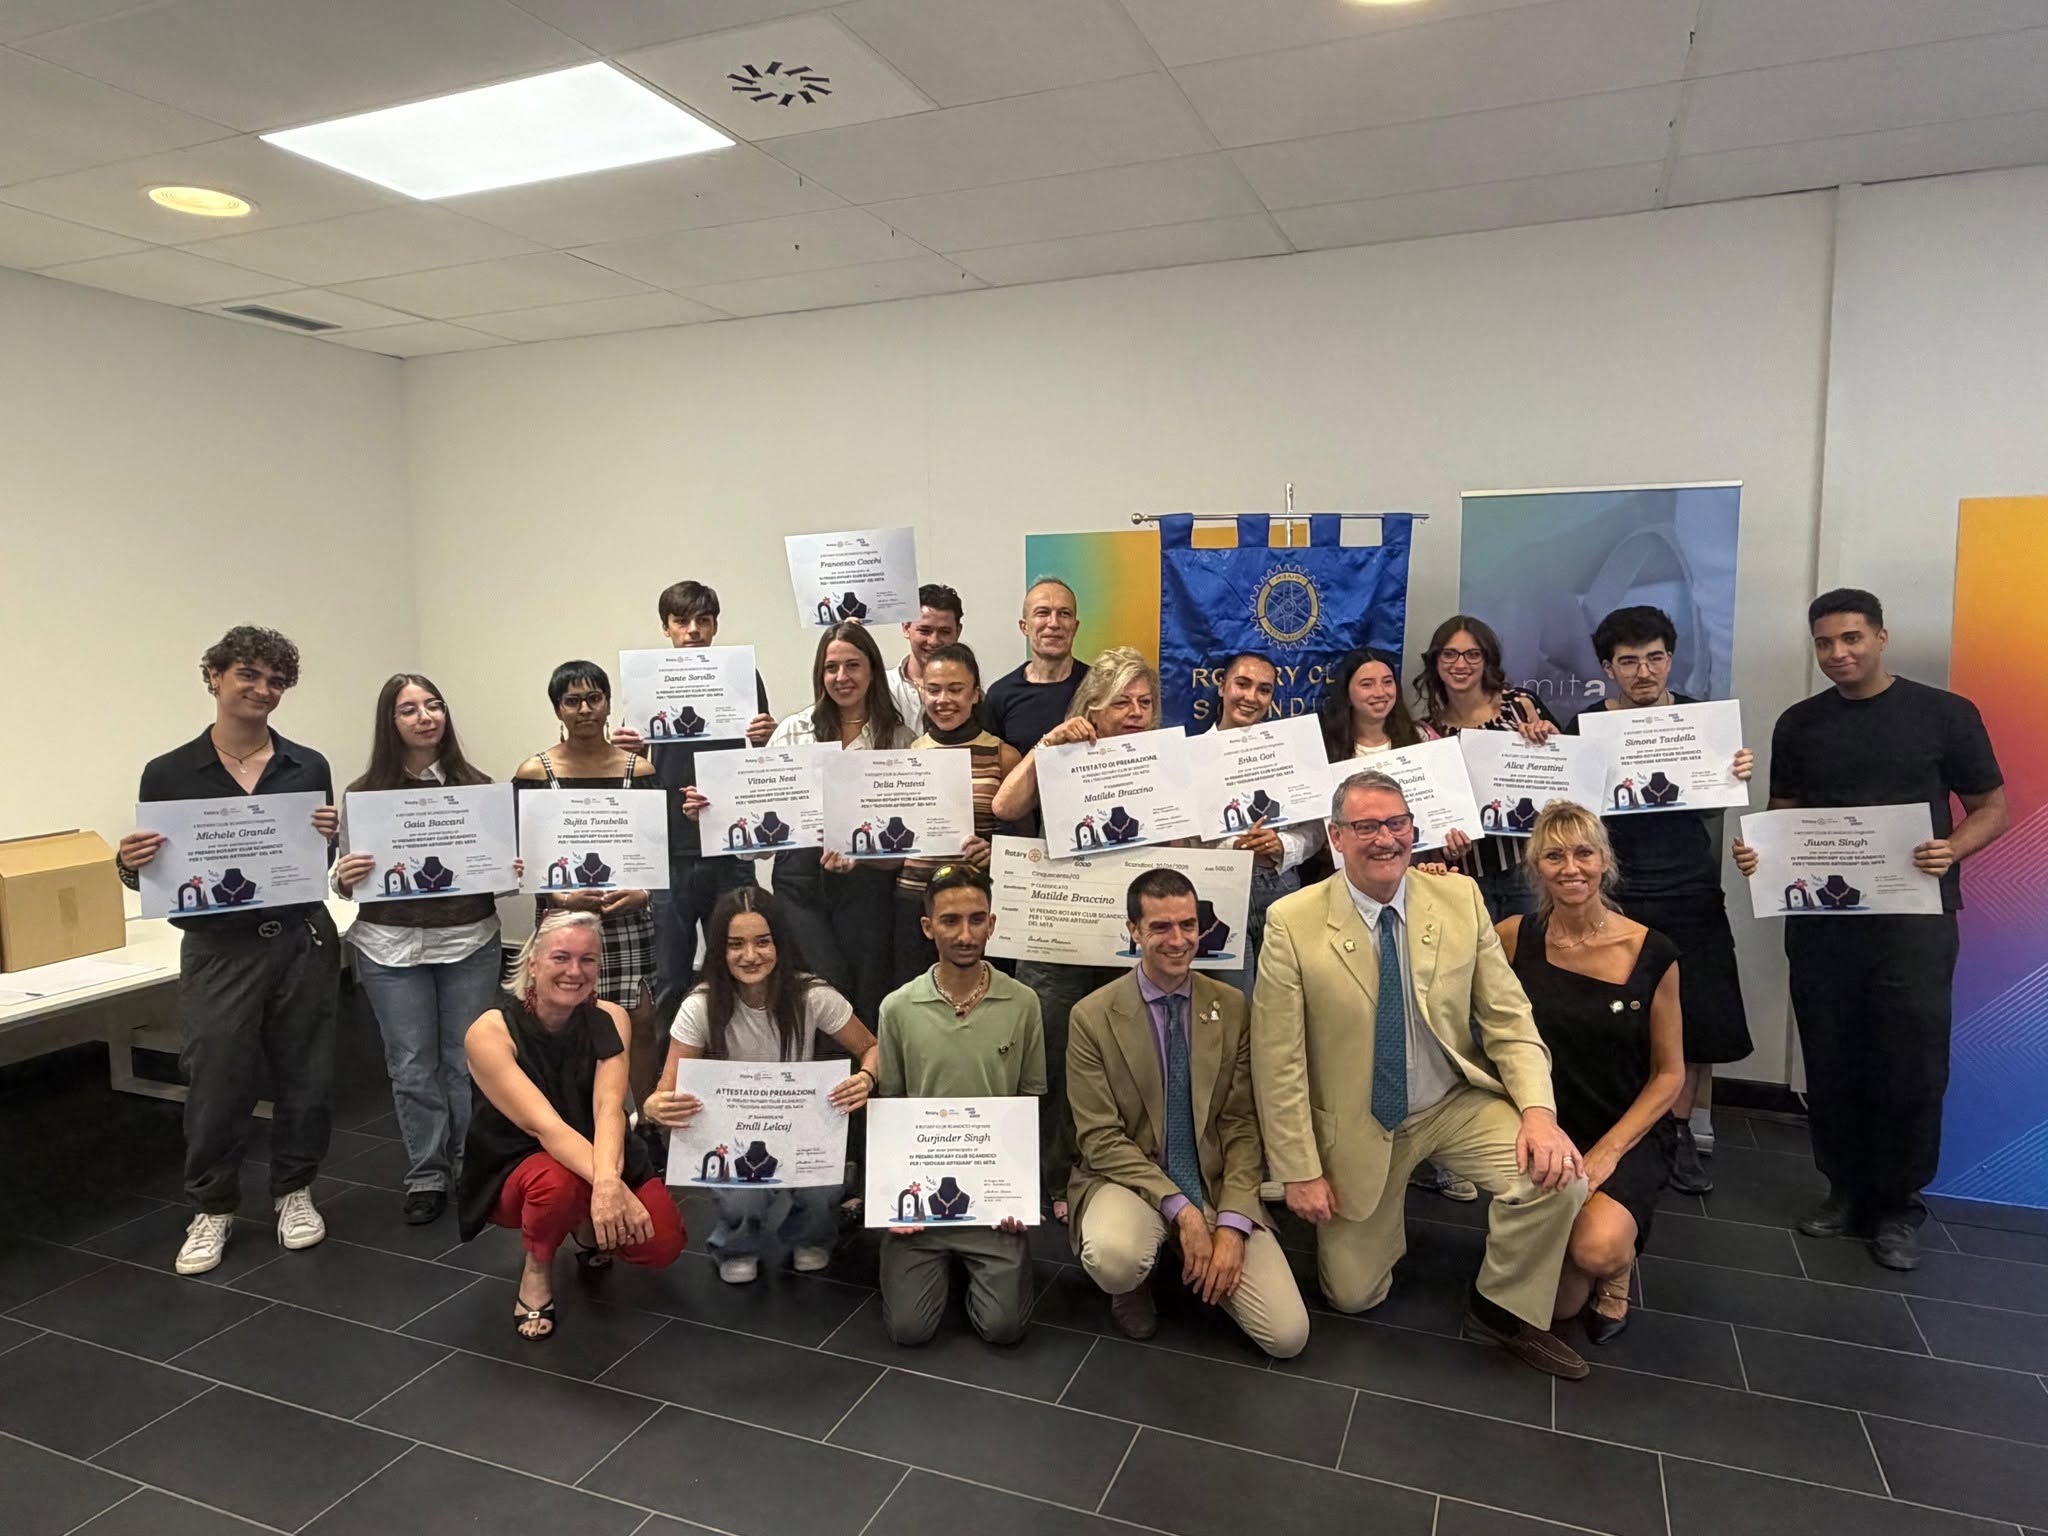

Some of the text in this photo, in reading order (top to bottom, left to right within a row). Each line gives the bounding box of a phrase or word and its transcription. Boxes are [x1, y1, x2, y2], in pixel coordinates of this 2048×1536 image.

[820, 560, 856, 568] Francesco
[688, 673, 716, 681] Sorvillo
[1192, 665, 1299, 688] RORY
[1522, 672, 1606, 697] mita
[1624, 733, 1696, 747] Simone Tardella
[1238, 751, 1276, 765] Erika Gori
[1070, 763, 1107, 774] ATTESTATO
[1116, 754, 1158, 766] PREMIAZIONE
[1504, 761, 1525, 770] Alice
[747, 776, 777, 785] Vittoria
[873, 780, 894, 789] Delia
[1084, 790, 1116, 803] Matilde
[1118, 785, 1154, 798] Braccino
[403, 816, 465, 829] Gaia Baccani
[563, 817, 588, 827] Sujita
[196, 826, 276, 841] Michele Grande
[1803, 838, 1868, 848] Jiwan Singh
[1004, 849, 1027, 859] Rotary
[1031, 890, 1115, 904] Matilde Braccino
[716, 1088, 816, 1097] ATTESTATO DI PREMIAZIONE
[736, 1121, 760, 1131] Emili
[916, 1132, 990, 1144] Gurjinder Singh
